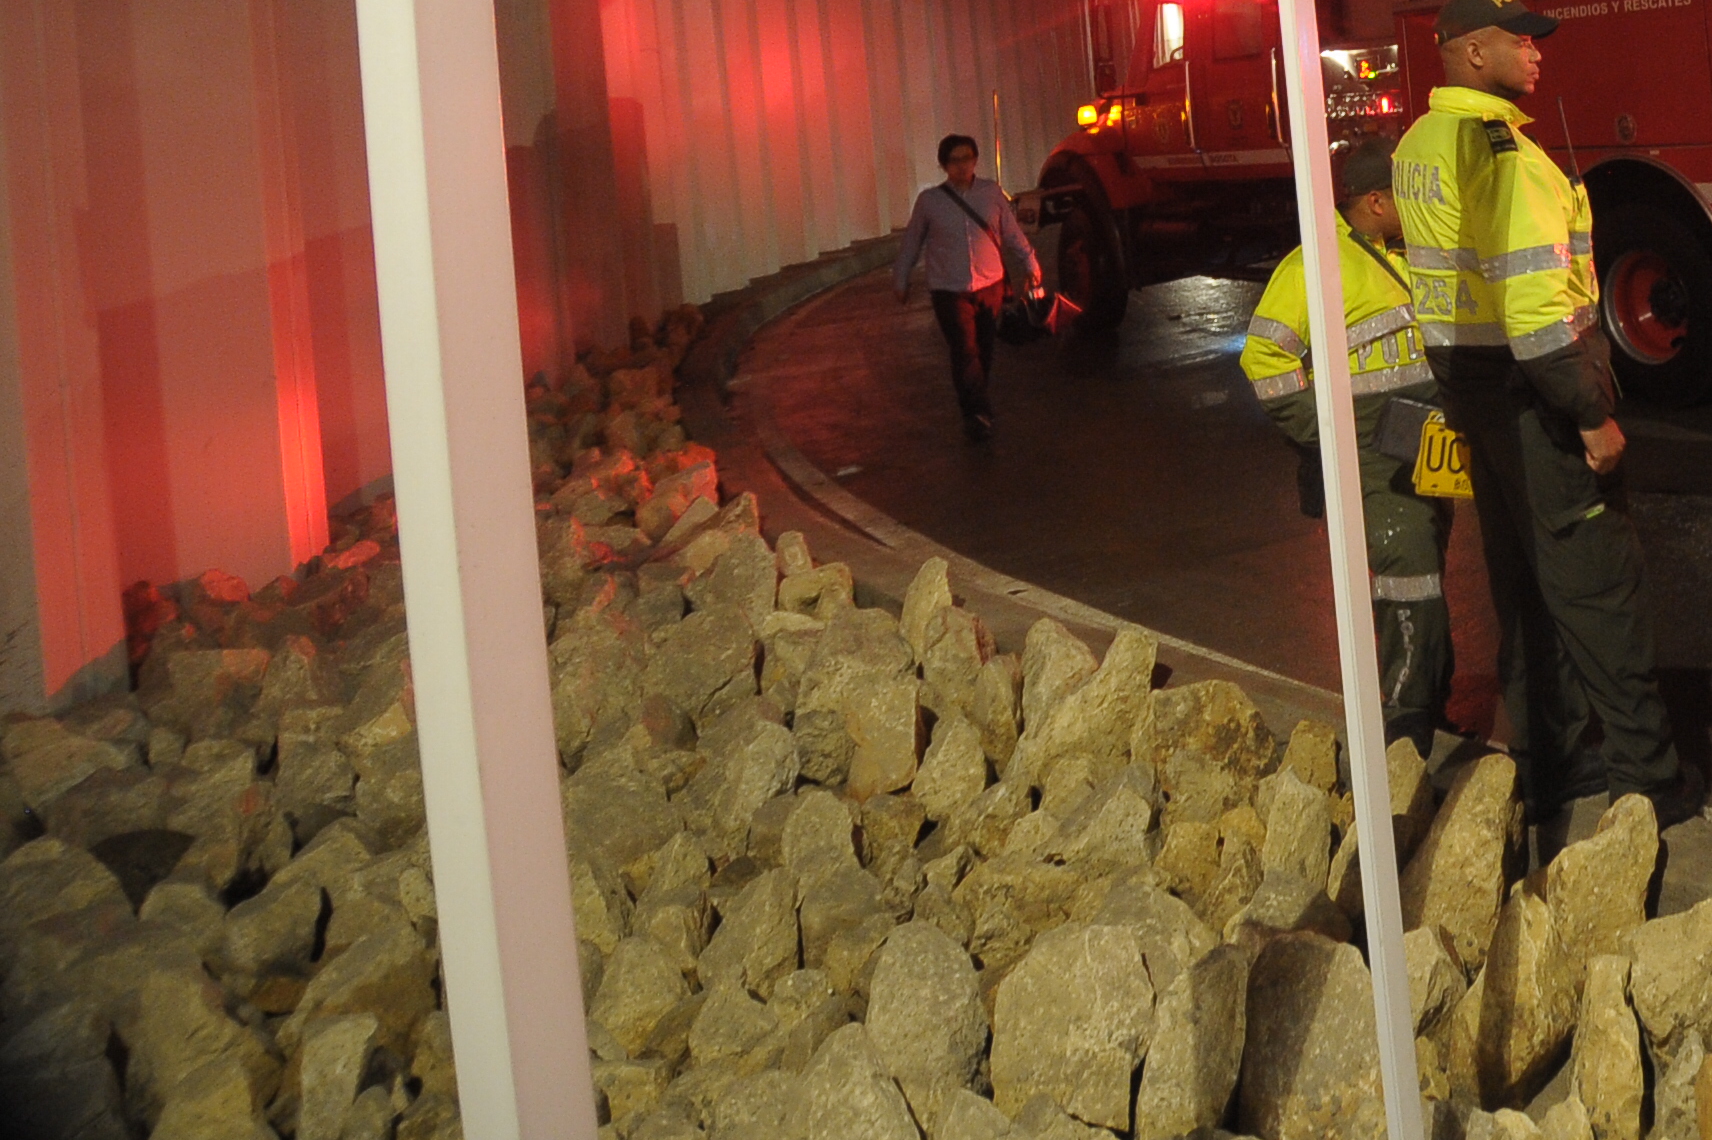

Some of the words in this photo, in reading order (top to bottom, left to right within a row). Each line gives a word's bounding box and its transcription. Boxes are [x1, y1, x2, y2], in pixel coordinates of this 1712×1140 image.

[1543, 1, 1609, 20] INCENDIOS
[1611, 0, 1620, 14] Y
[1415, 278, 1479, 316] 254
